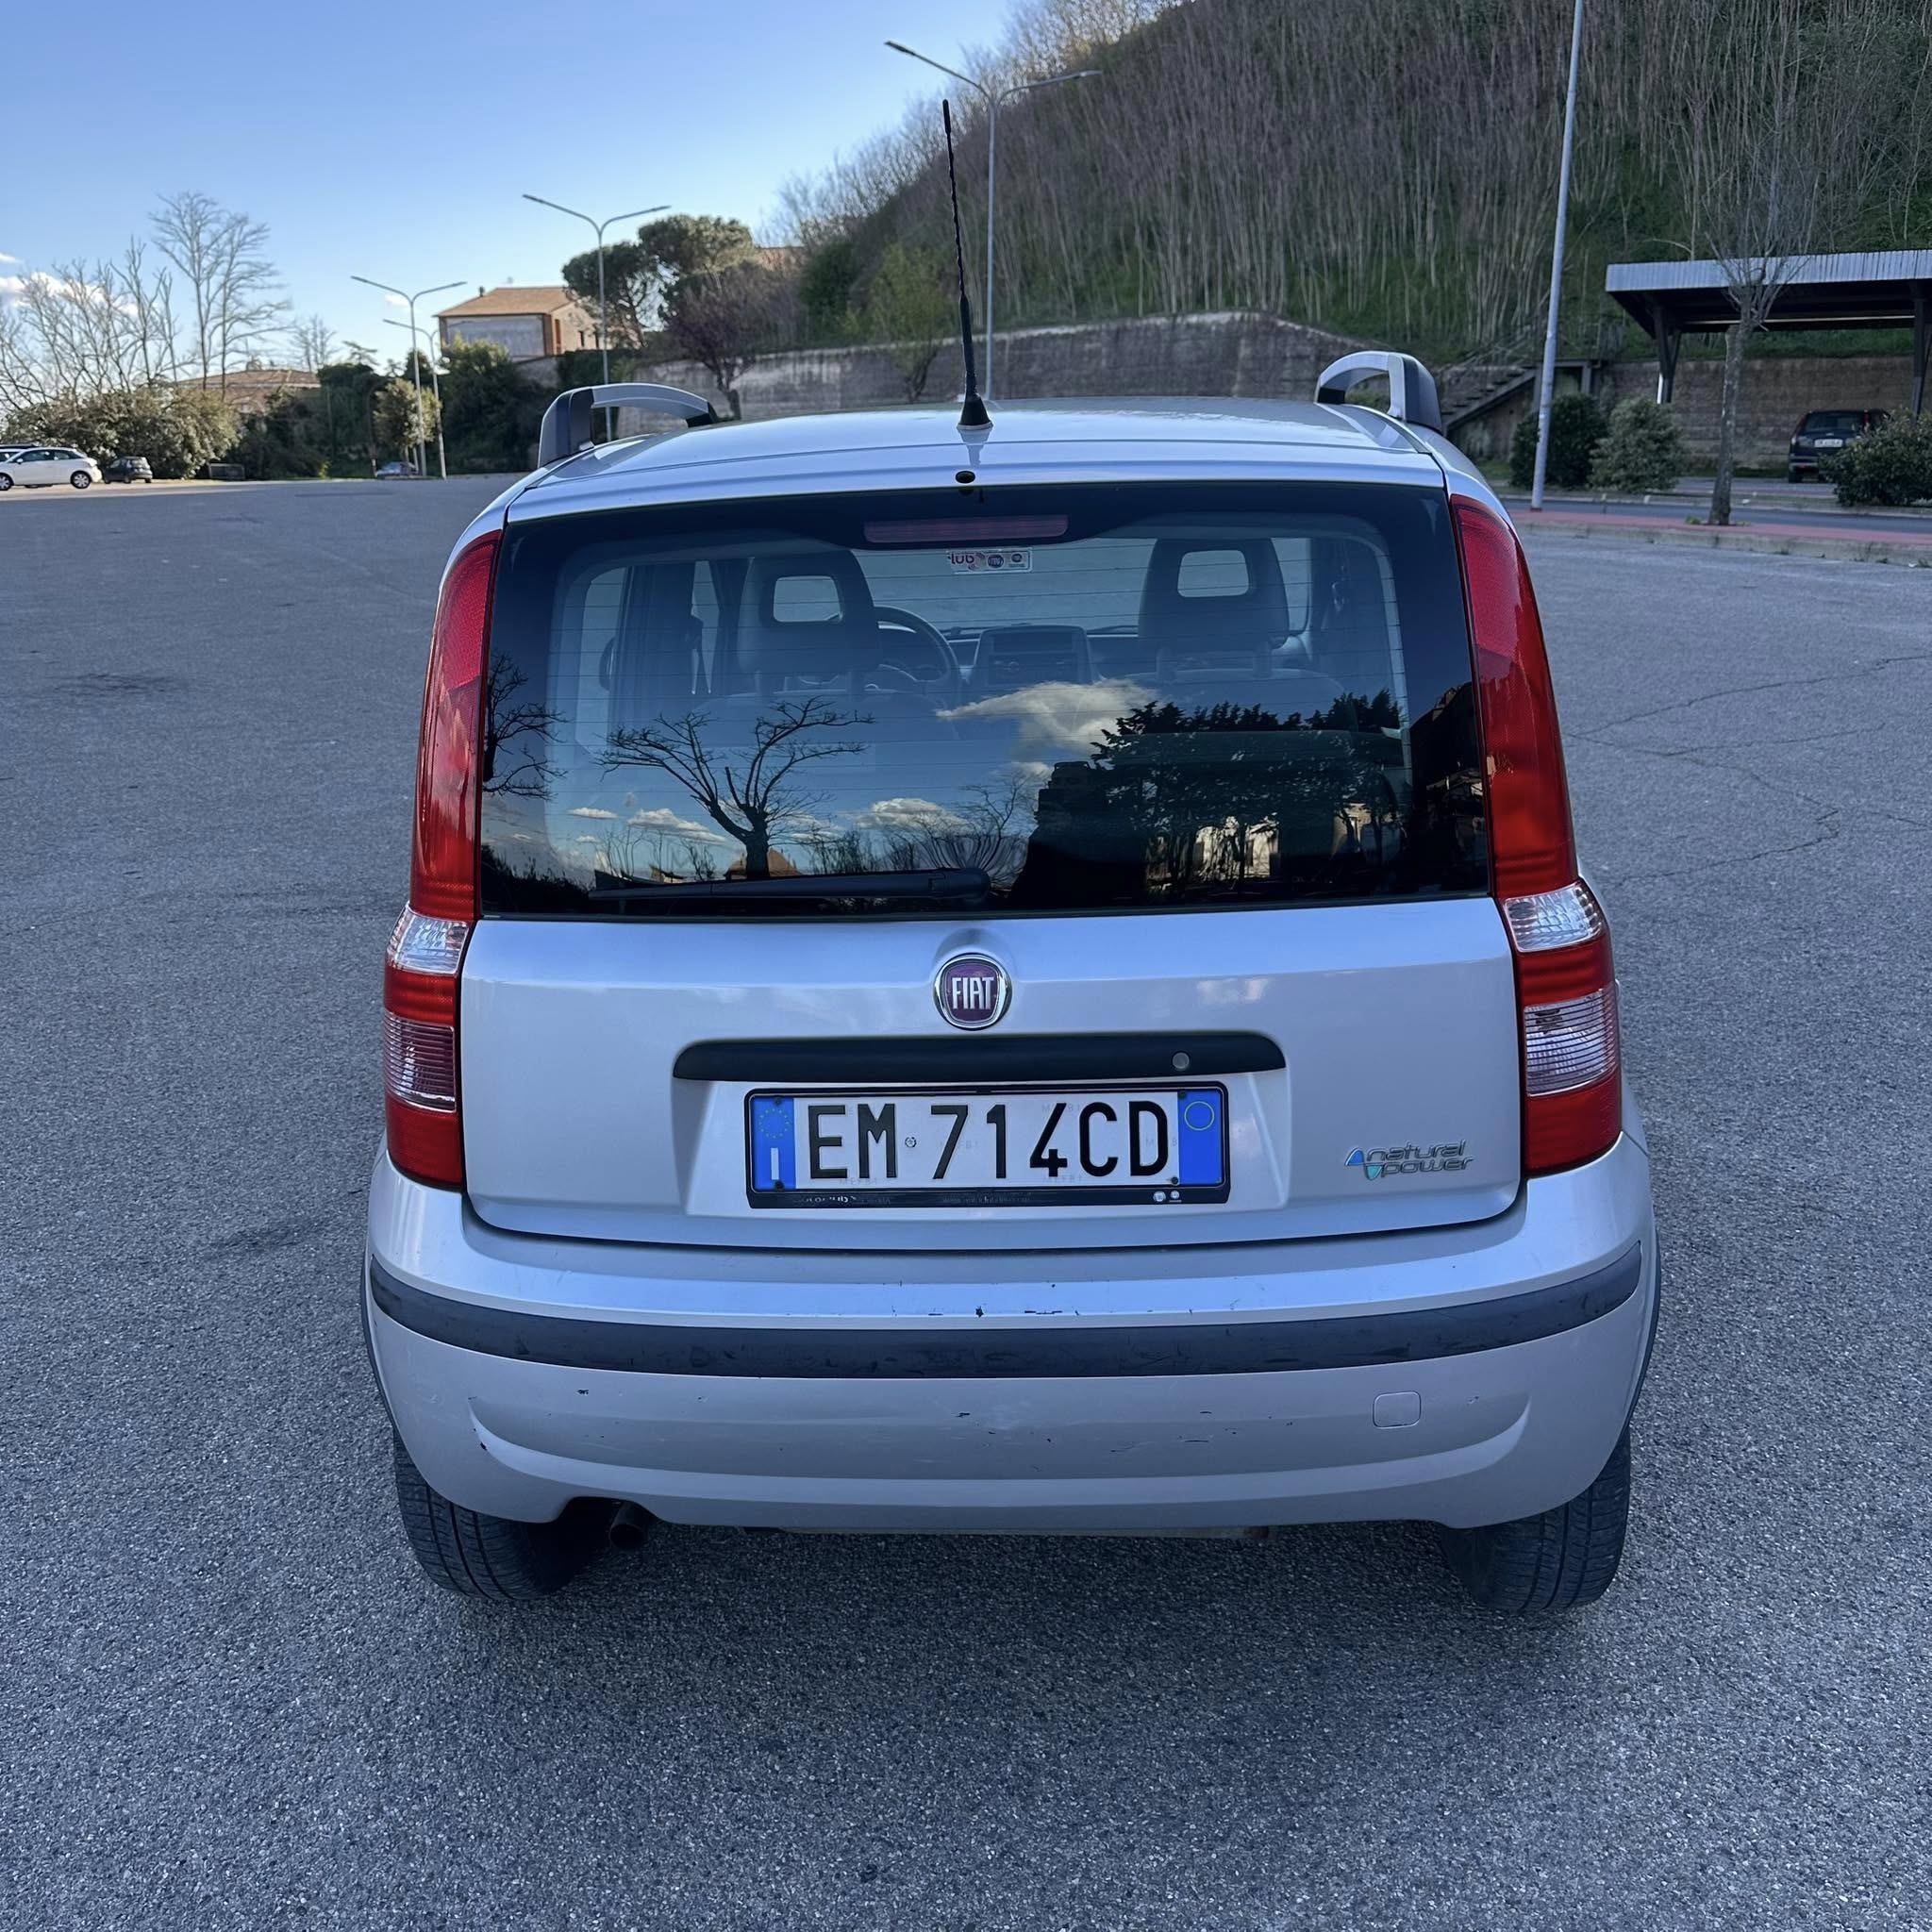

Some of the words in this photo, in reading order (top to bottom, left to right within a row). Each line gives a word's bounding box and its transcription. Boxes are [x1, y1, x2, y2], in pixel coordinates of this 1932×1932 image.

[951, 976, 994, 1010] FIAT
[808, 1103, 898, 1179] EM
[930, 1100, 1169, 1179] 714CD
[1366, 1139, 1467, 1162] natural
[1380, 1156, 1475, 1178] power
